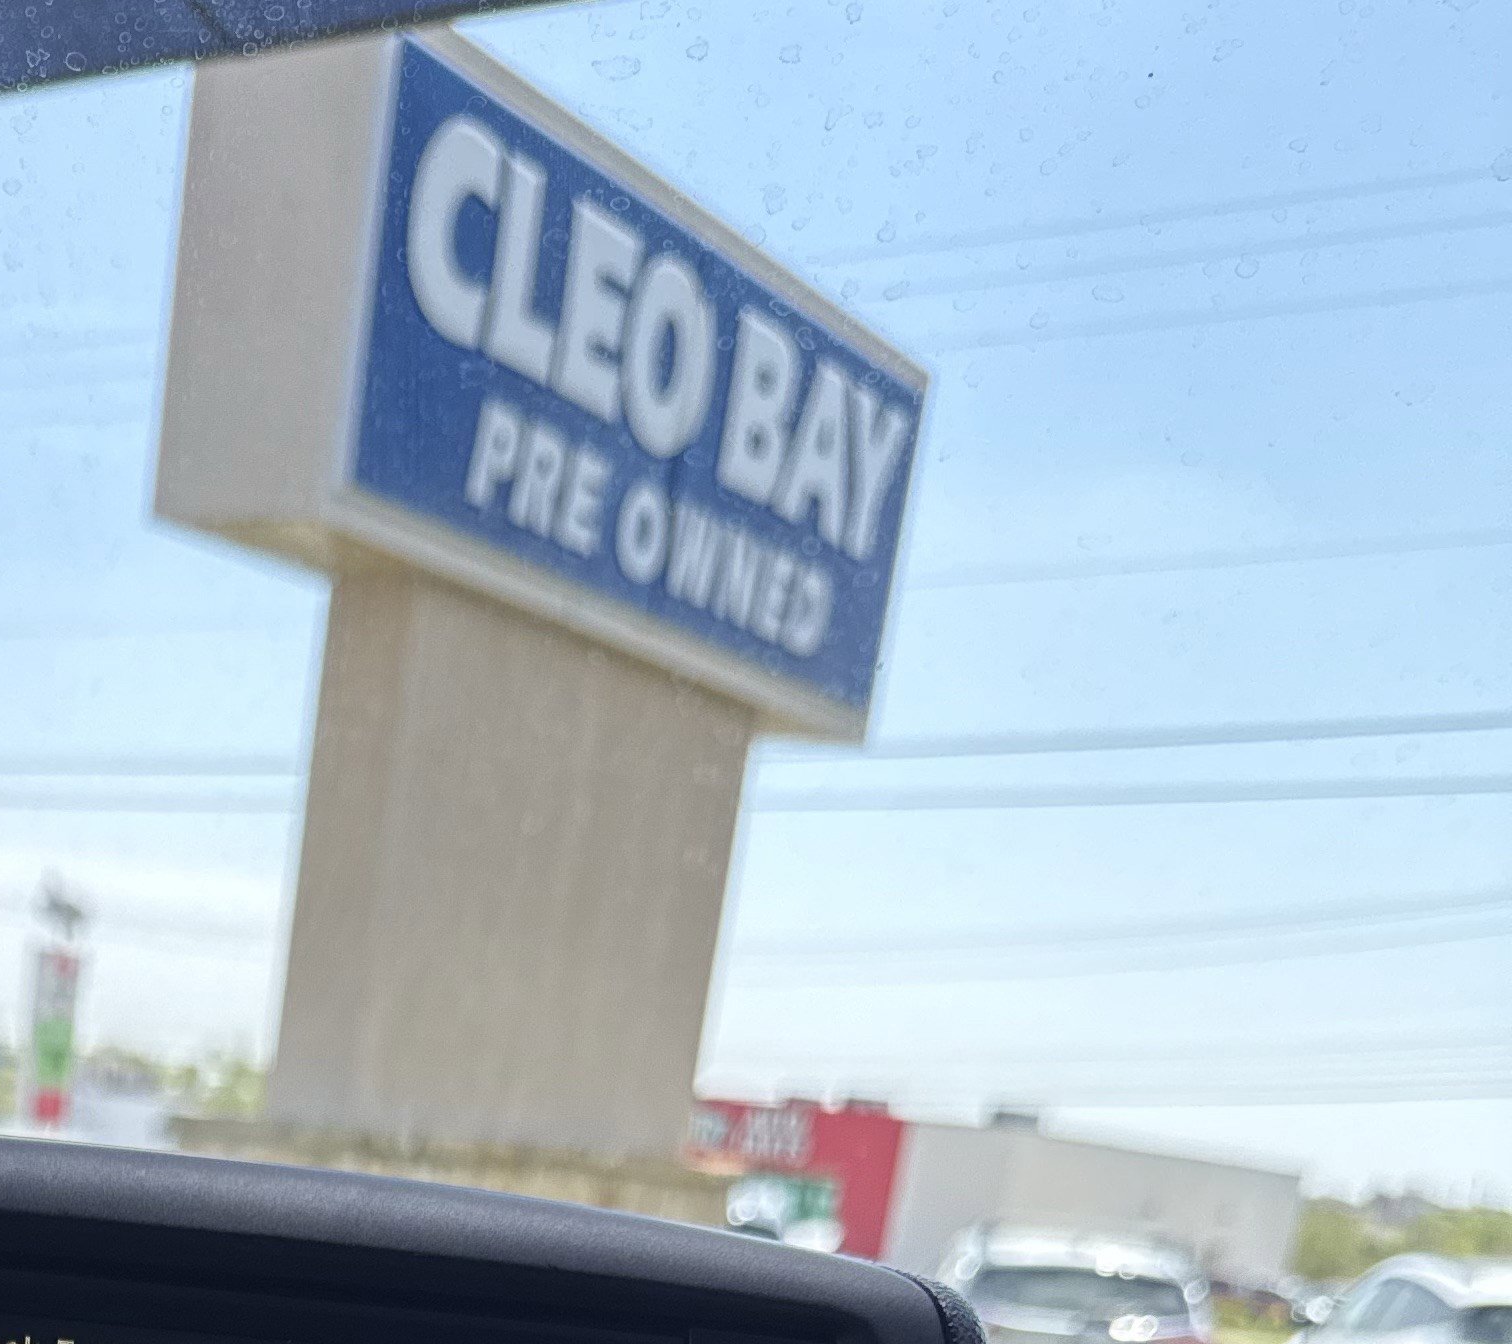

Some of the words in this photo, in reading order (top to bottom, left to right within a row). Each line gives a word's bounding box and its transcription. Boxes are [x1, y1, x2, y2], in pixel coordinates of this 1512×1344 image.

[407, 113, 716, 459] CLEO
[717, 304, 908, 562] BAY
[465, 399, 611, 557] PRE
[615, 479, 834, 657] OWNED
